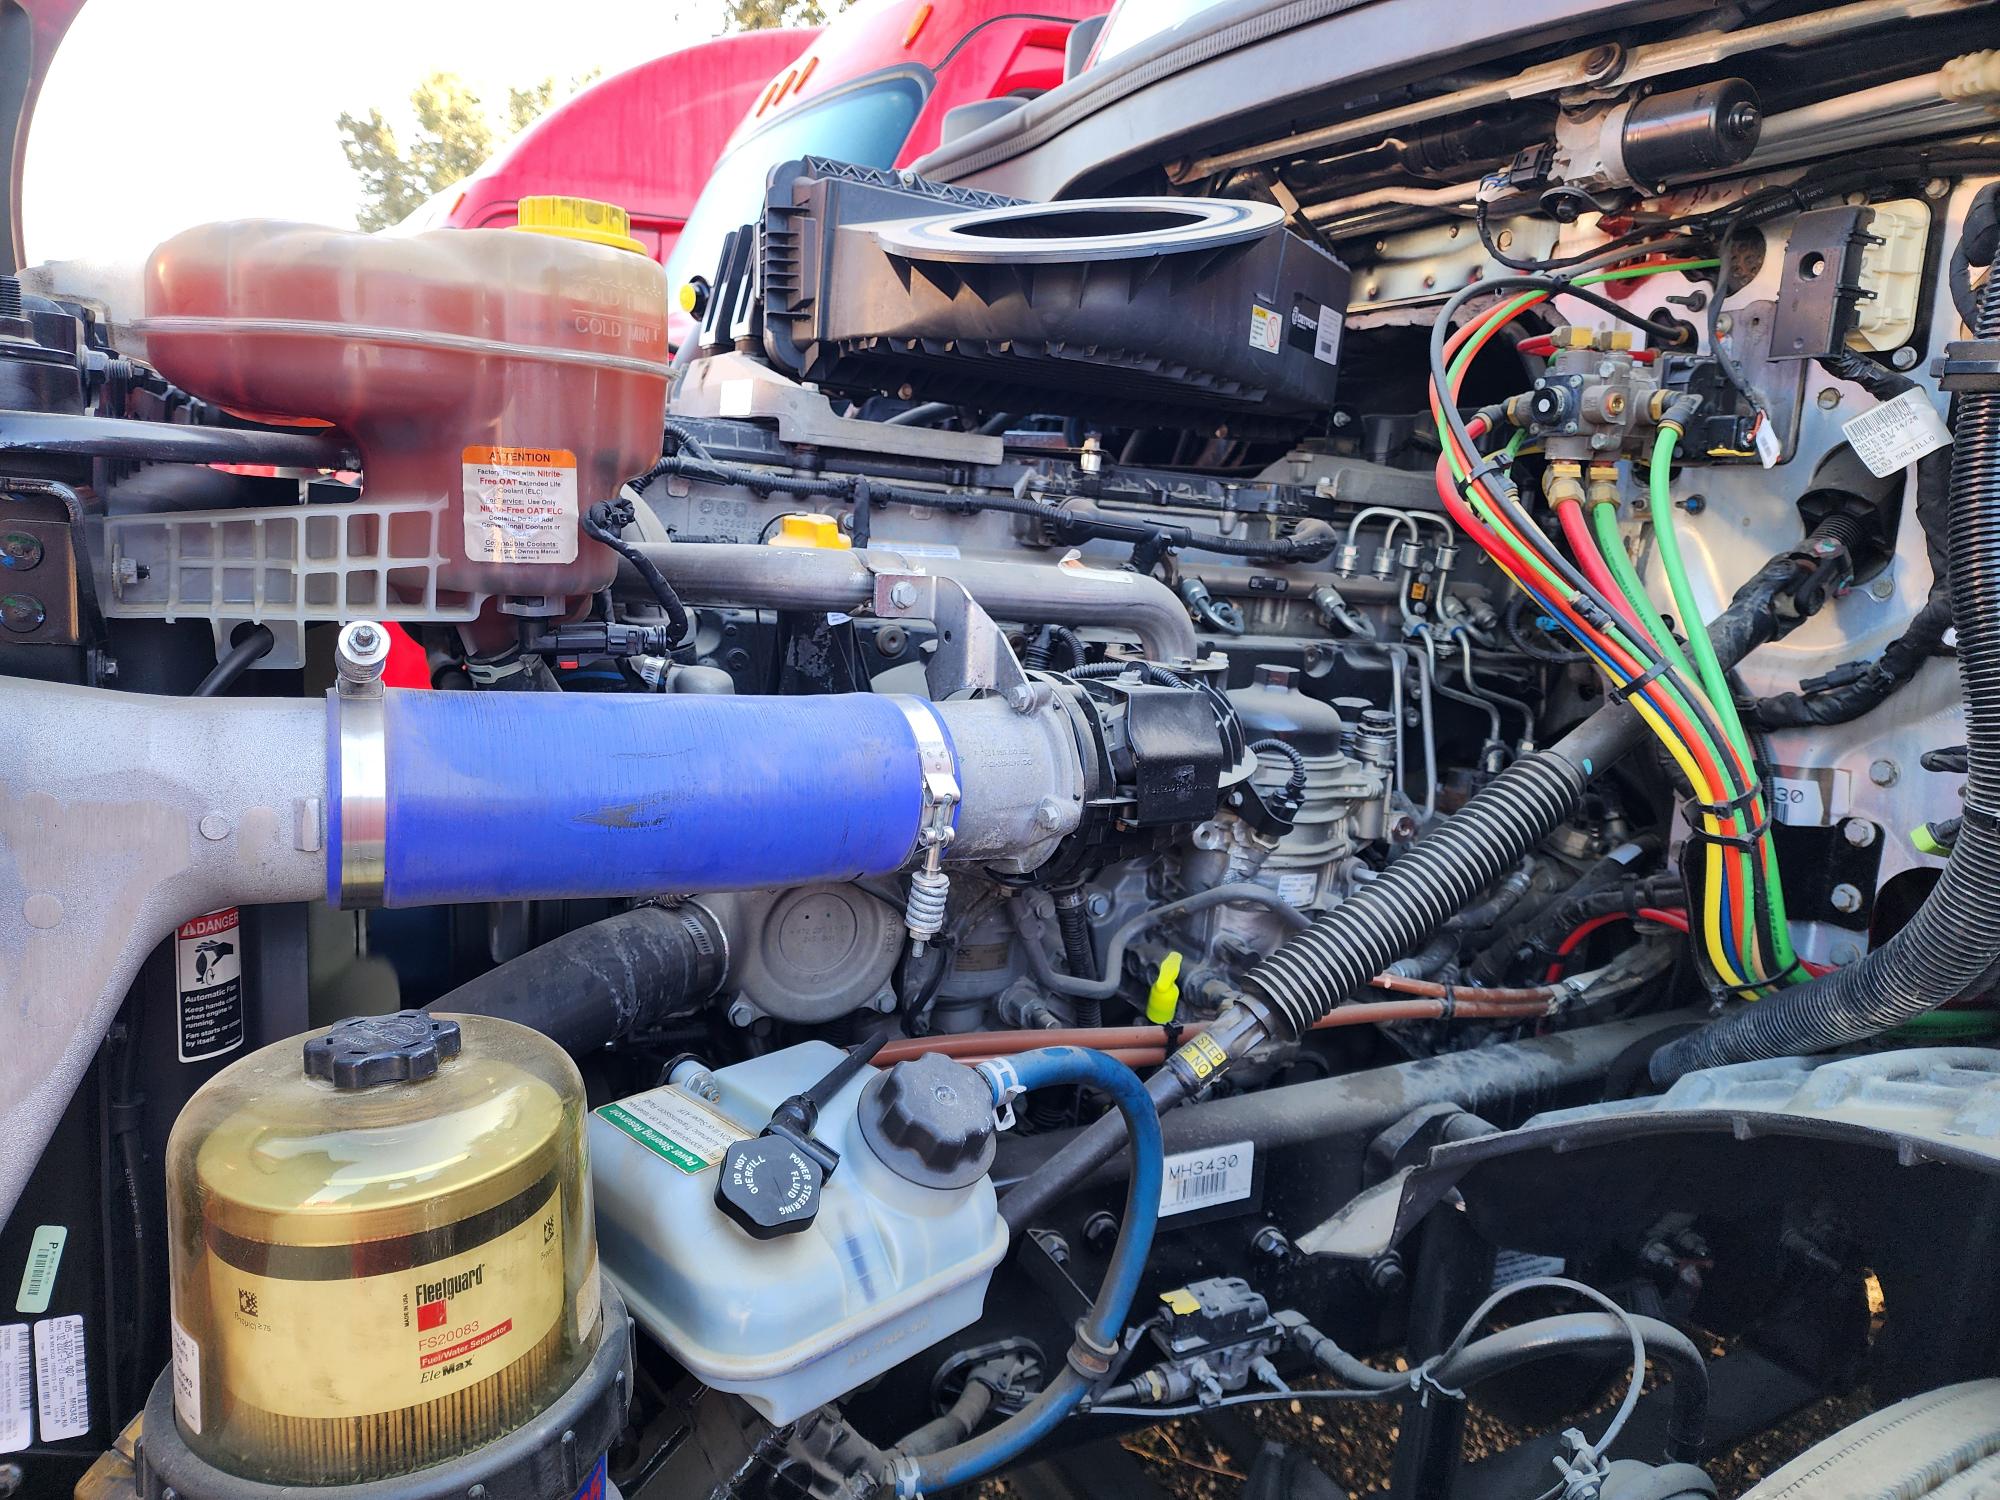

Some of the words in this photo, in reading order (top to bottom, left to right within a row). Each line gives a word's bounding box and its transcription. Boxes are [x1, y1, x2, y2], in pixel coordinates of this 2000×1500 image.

[575, 316, 621, 337] COLD
[480, 477, 497, 485] Free
[499, 478, 518, 486] OAT
[547, 507, 563, 515] ELC
[196, 911, 239, 934] DANGER
[184, 989, 226, 1003] Automatic
[185, 1006, 204, 1014] Keep
[206, 1000, 225, 1010] hands
[206, 1007, 228, 1017] engine
[185, 1019, 215, 1029] running.
[201, 1027, 221, 1037] starts
[185, 1040, 196, 1048] by
[197, 1036, 216, 1045] itself.
[1198, 1036, 1223, 1067] STEP
[1193, 1055, 1209, 1075] NO
[639, 1129, 675, 1151] Steering
[669, 1147, 699, 1166] Power
[734, 1153, 748, 1170] NOT
[789, 1152, 812, 1181] POWER
[744, 1154, 766, 1195] OVERFILL
[1169, 1154, 1239, 1181] MH3430
[733, 1173, 743, 1185] DO
[787, 1170, 801, 1199] FLUID
[779, 1184, 812, 1215] STEERING
[415, 1263, 483, 1307] Fleetguard
[418, 1320, 480, 1351] FS20083
[422, 1343, 469, 1367] Fuel/Water
[470, 1325, 508, 1349] Separator
